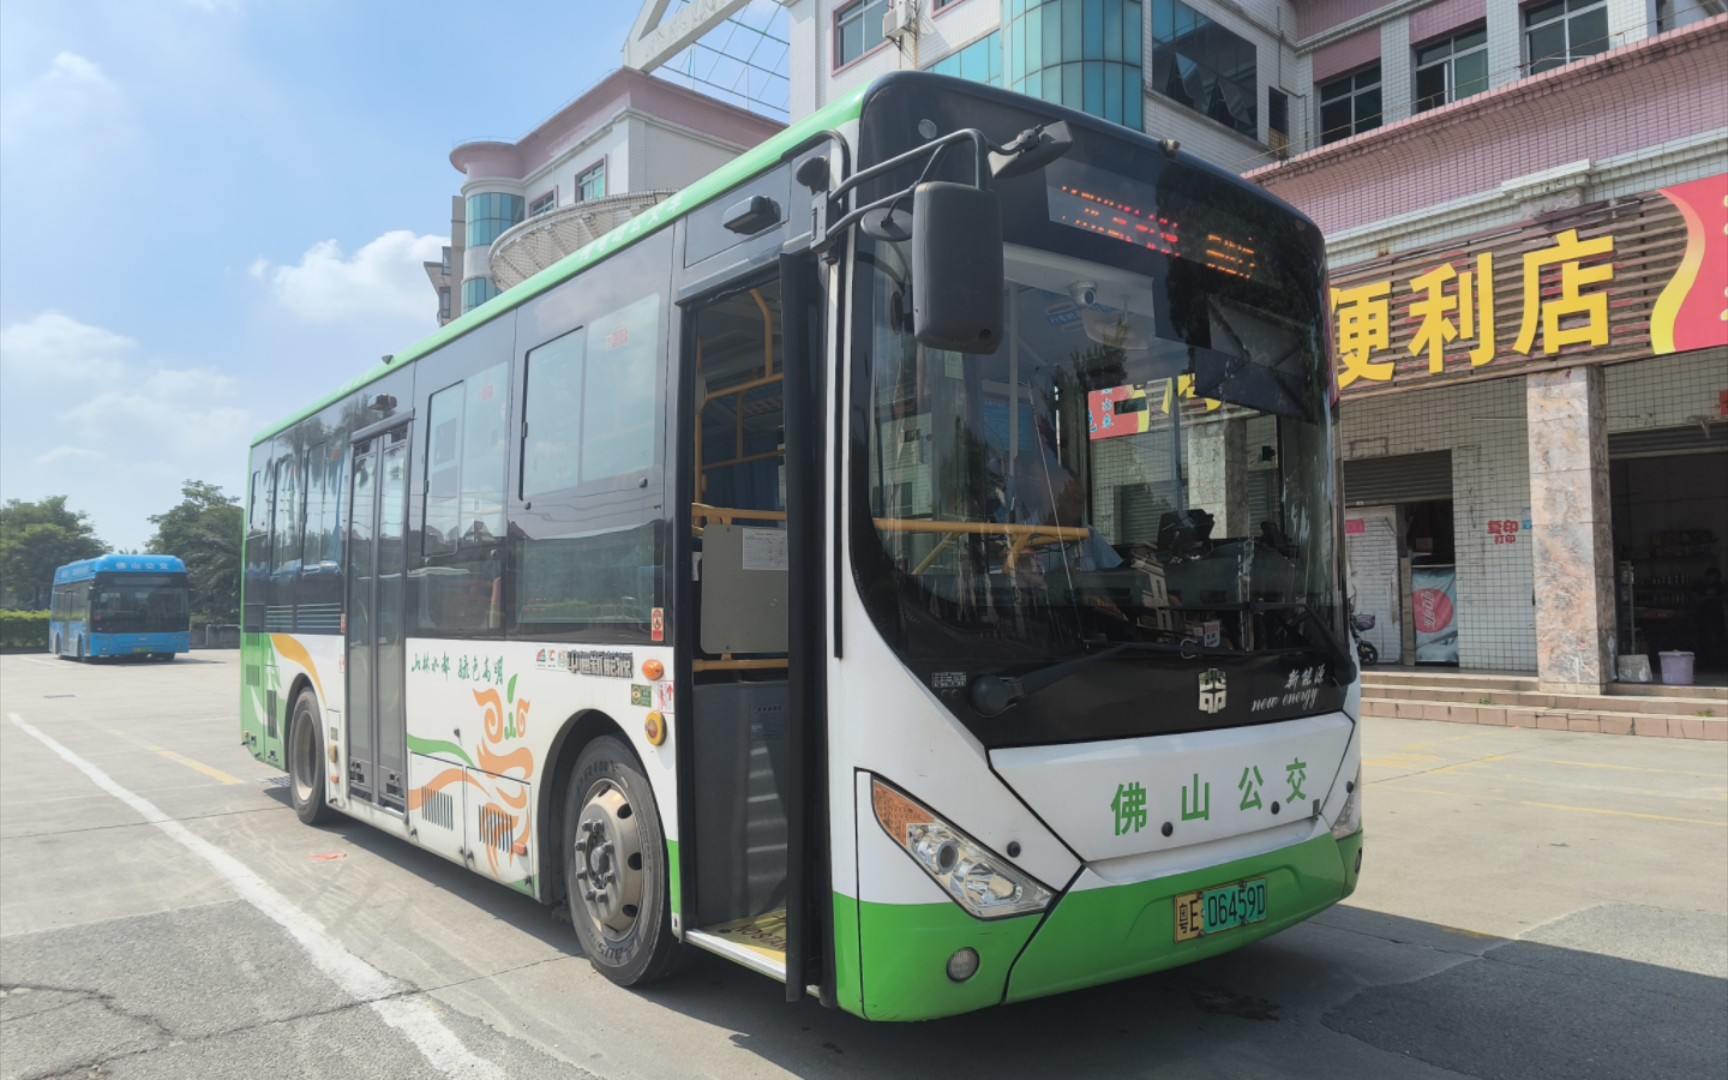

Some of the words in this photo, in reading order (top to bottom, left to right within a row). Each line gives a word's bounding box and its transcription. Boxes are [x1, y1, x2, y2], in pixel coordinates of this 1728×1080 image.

[1331, 228, 1614, 389] 便利店
[1282, 688, 1319, 711] energy
[1284, 663, 1326, 691] 新能源
[1111, 758, 1307, 836] 佛山公交
